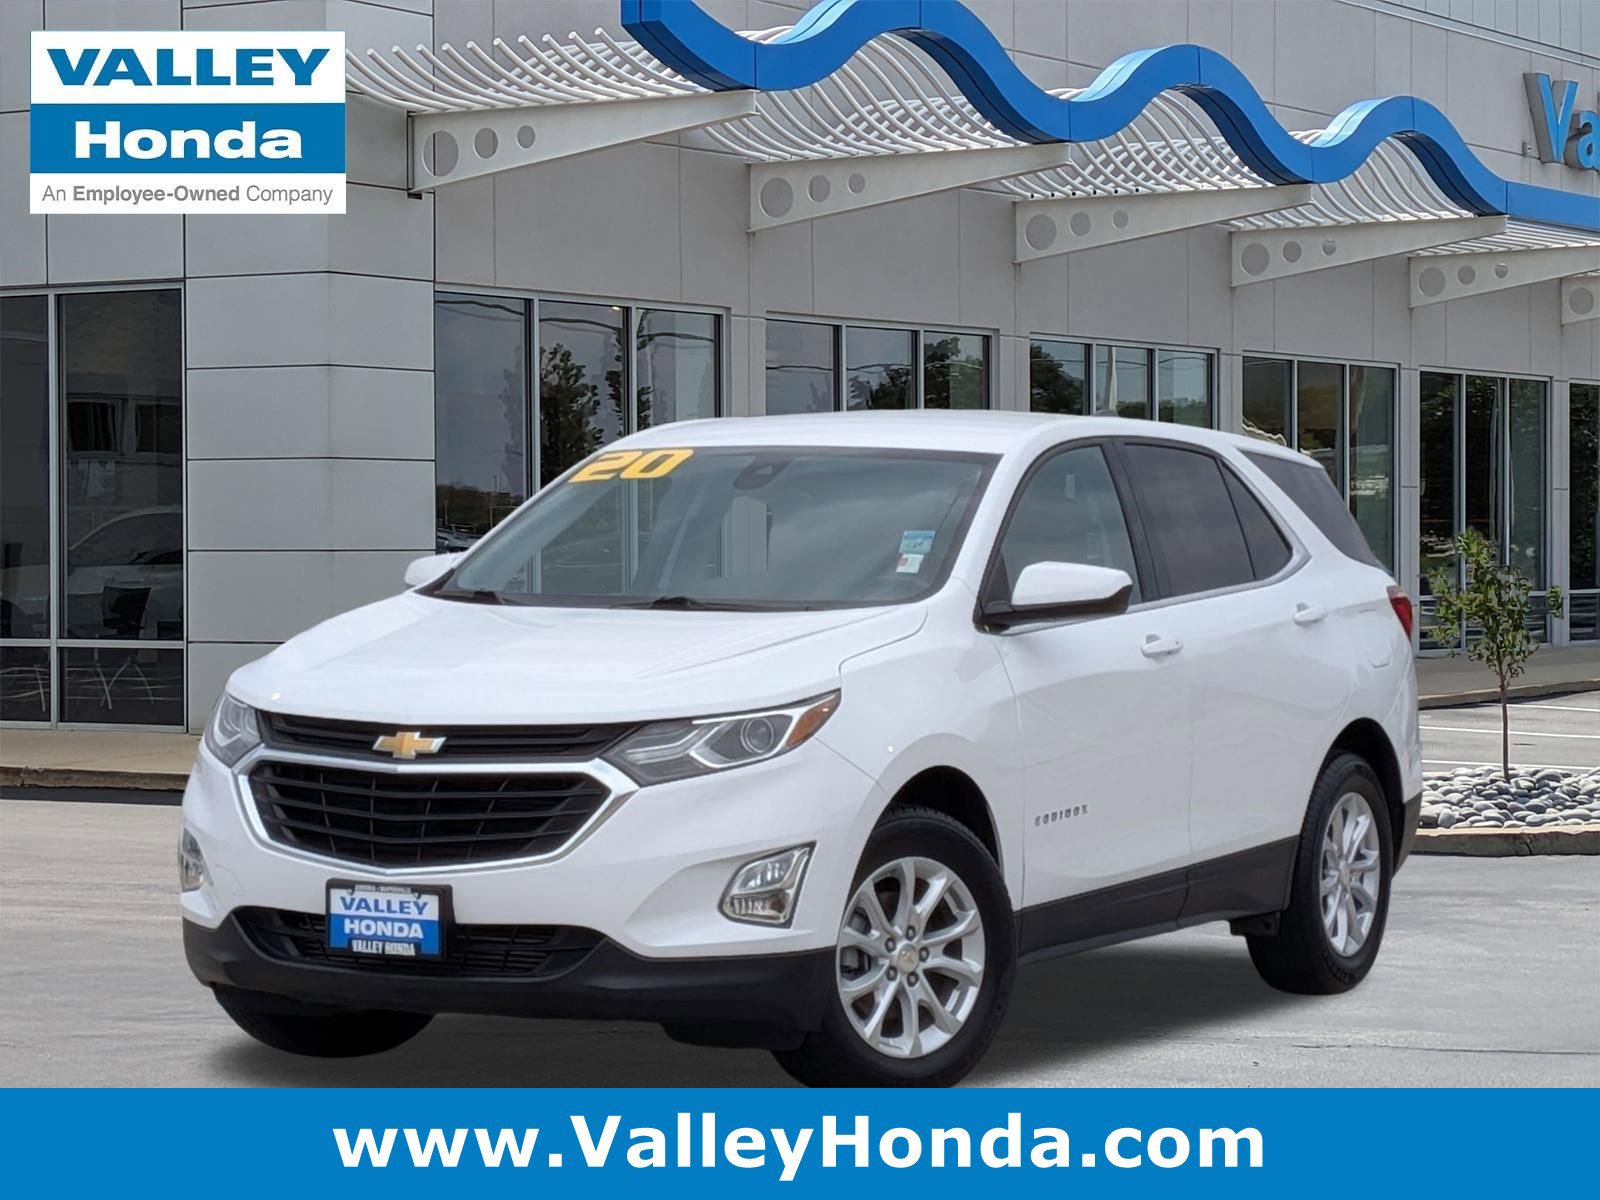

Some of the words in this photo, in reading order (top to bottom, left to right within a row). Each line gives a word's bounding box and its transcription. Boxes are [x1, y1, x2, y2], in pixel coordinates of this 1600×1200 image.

[567, 449, 694, 483] 20
[340, 896, 428, 915] VALLEY
[343, 918, 424, 939] HONDA
[351, 939, 383, 954] VALLEY
